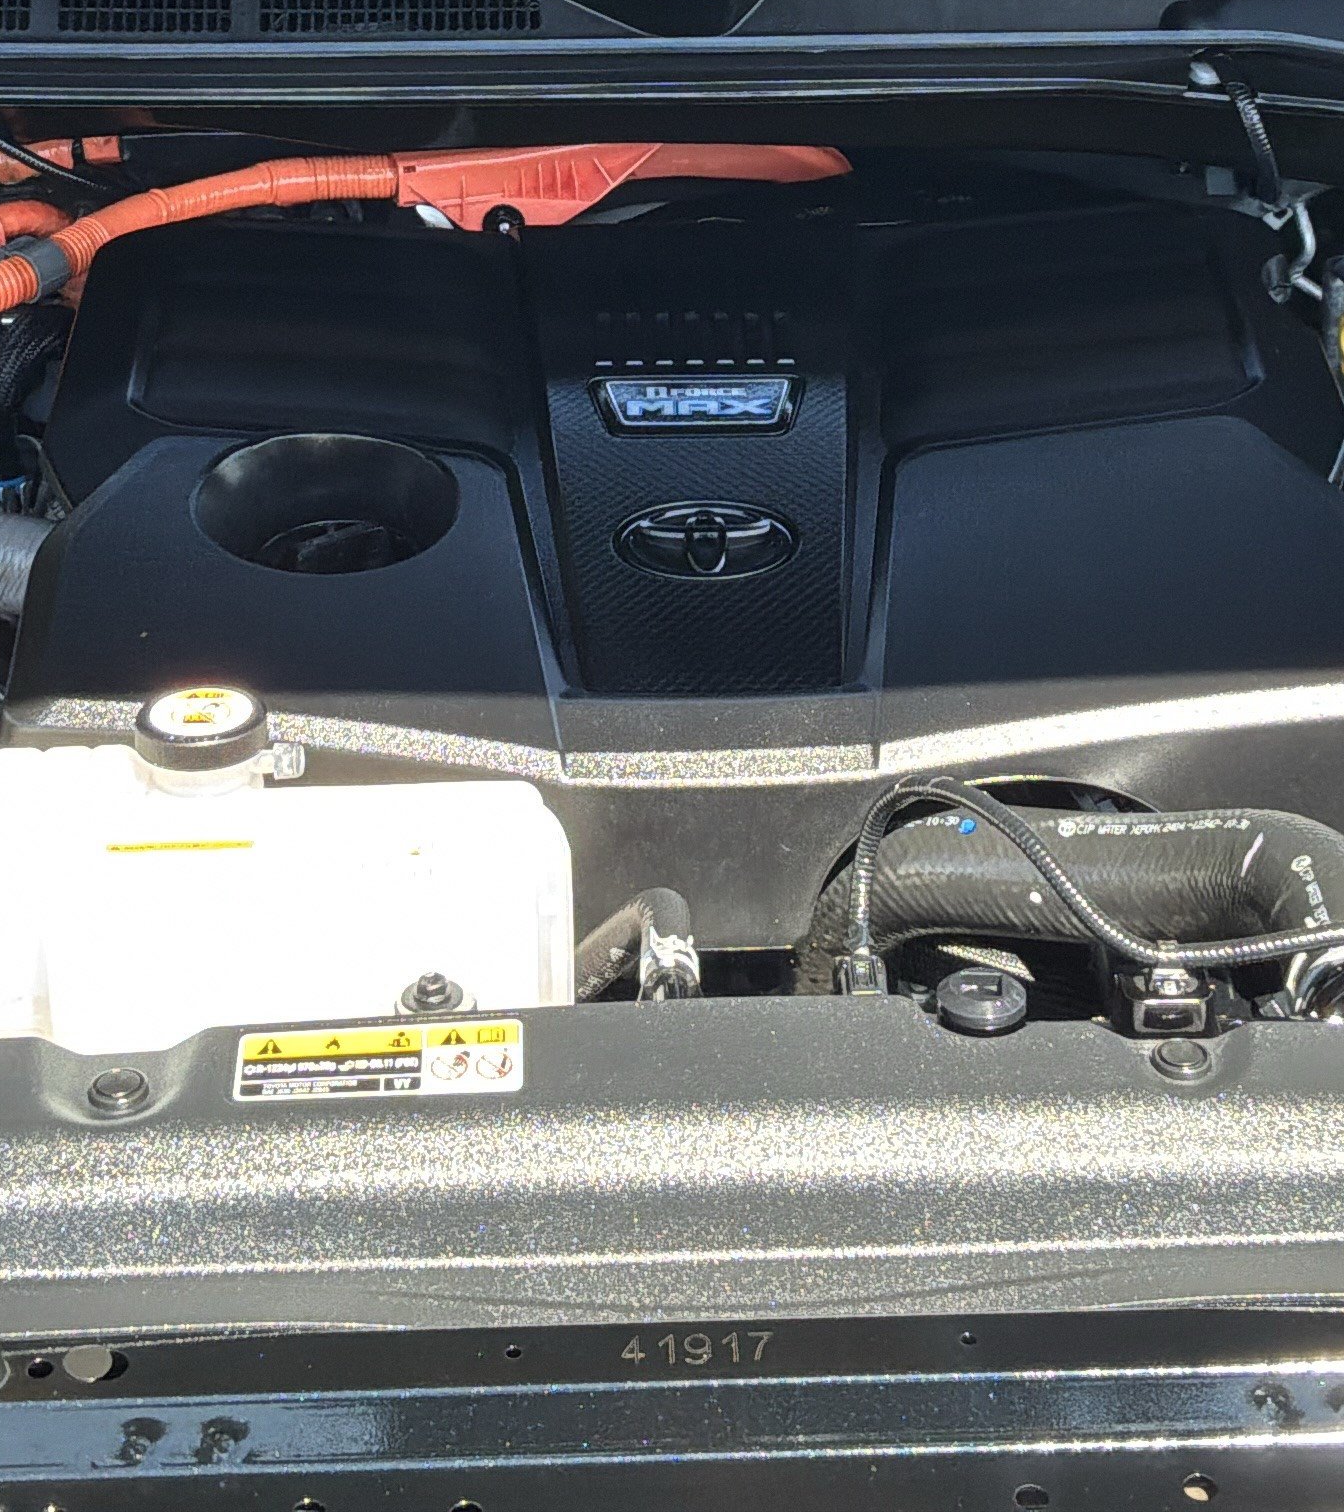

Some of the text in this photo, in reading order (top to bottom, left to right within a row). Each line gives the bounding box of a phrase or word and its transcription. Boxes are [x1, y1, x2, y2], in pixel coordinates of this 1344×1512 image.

[626, 398, 773, 417] MAX
[1097, 823, 1128, 836] WATER
[620, 1331, 775, 1365] 41917
